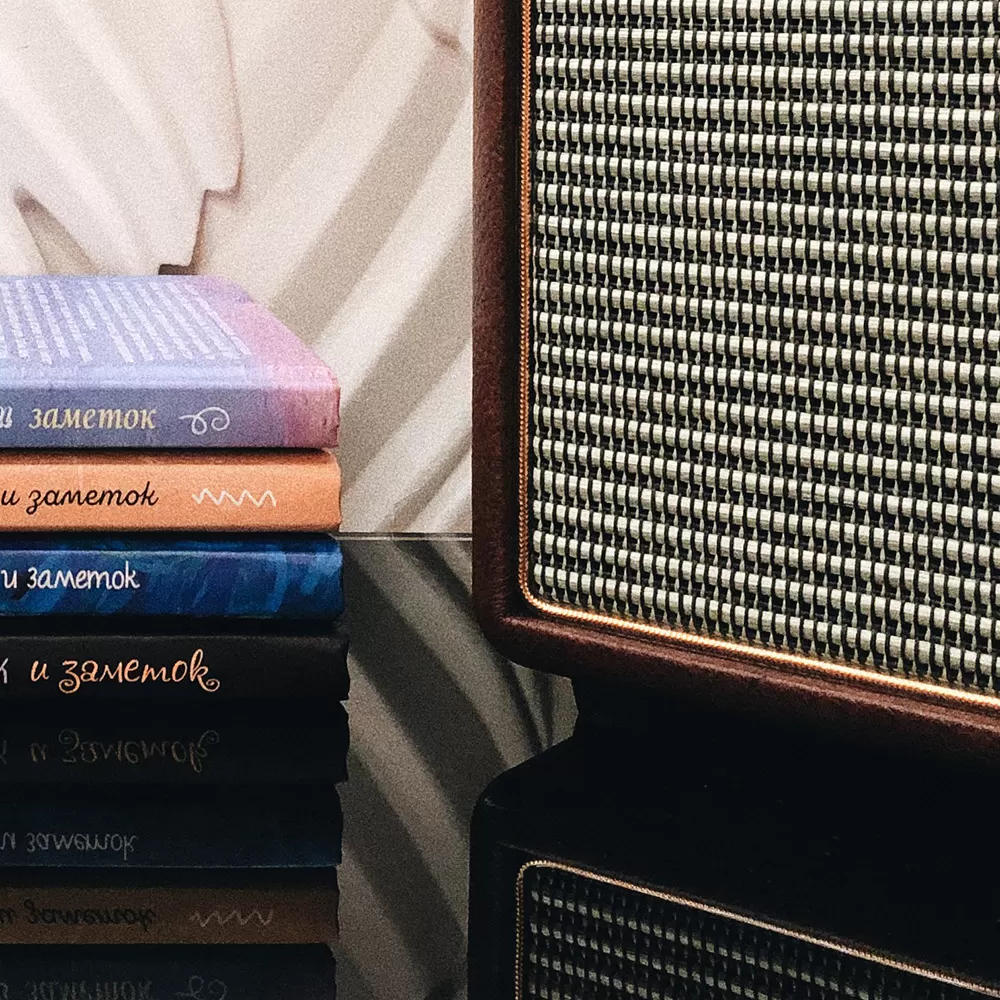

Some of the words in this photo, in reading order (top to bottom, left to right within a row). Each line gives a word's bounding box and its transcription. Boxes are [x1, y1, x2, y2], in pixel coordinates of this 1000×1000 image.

[28, 406, 157, 430] заметок
[0, 487, 20, 506] и
[25, 481, 159, 515] заметок
[0, 570, 18, 590] и
[26, 560, 141, 590] заметок
[30, 660, 49, 683] и
[59, 648, 220, 694] заметок
